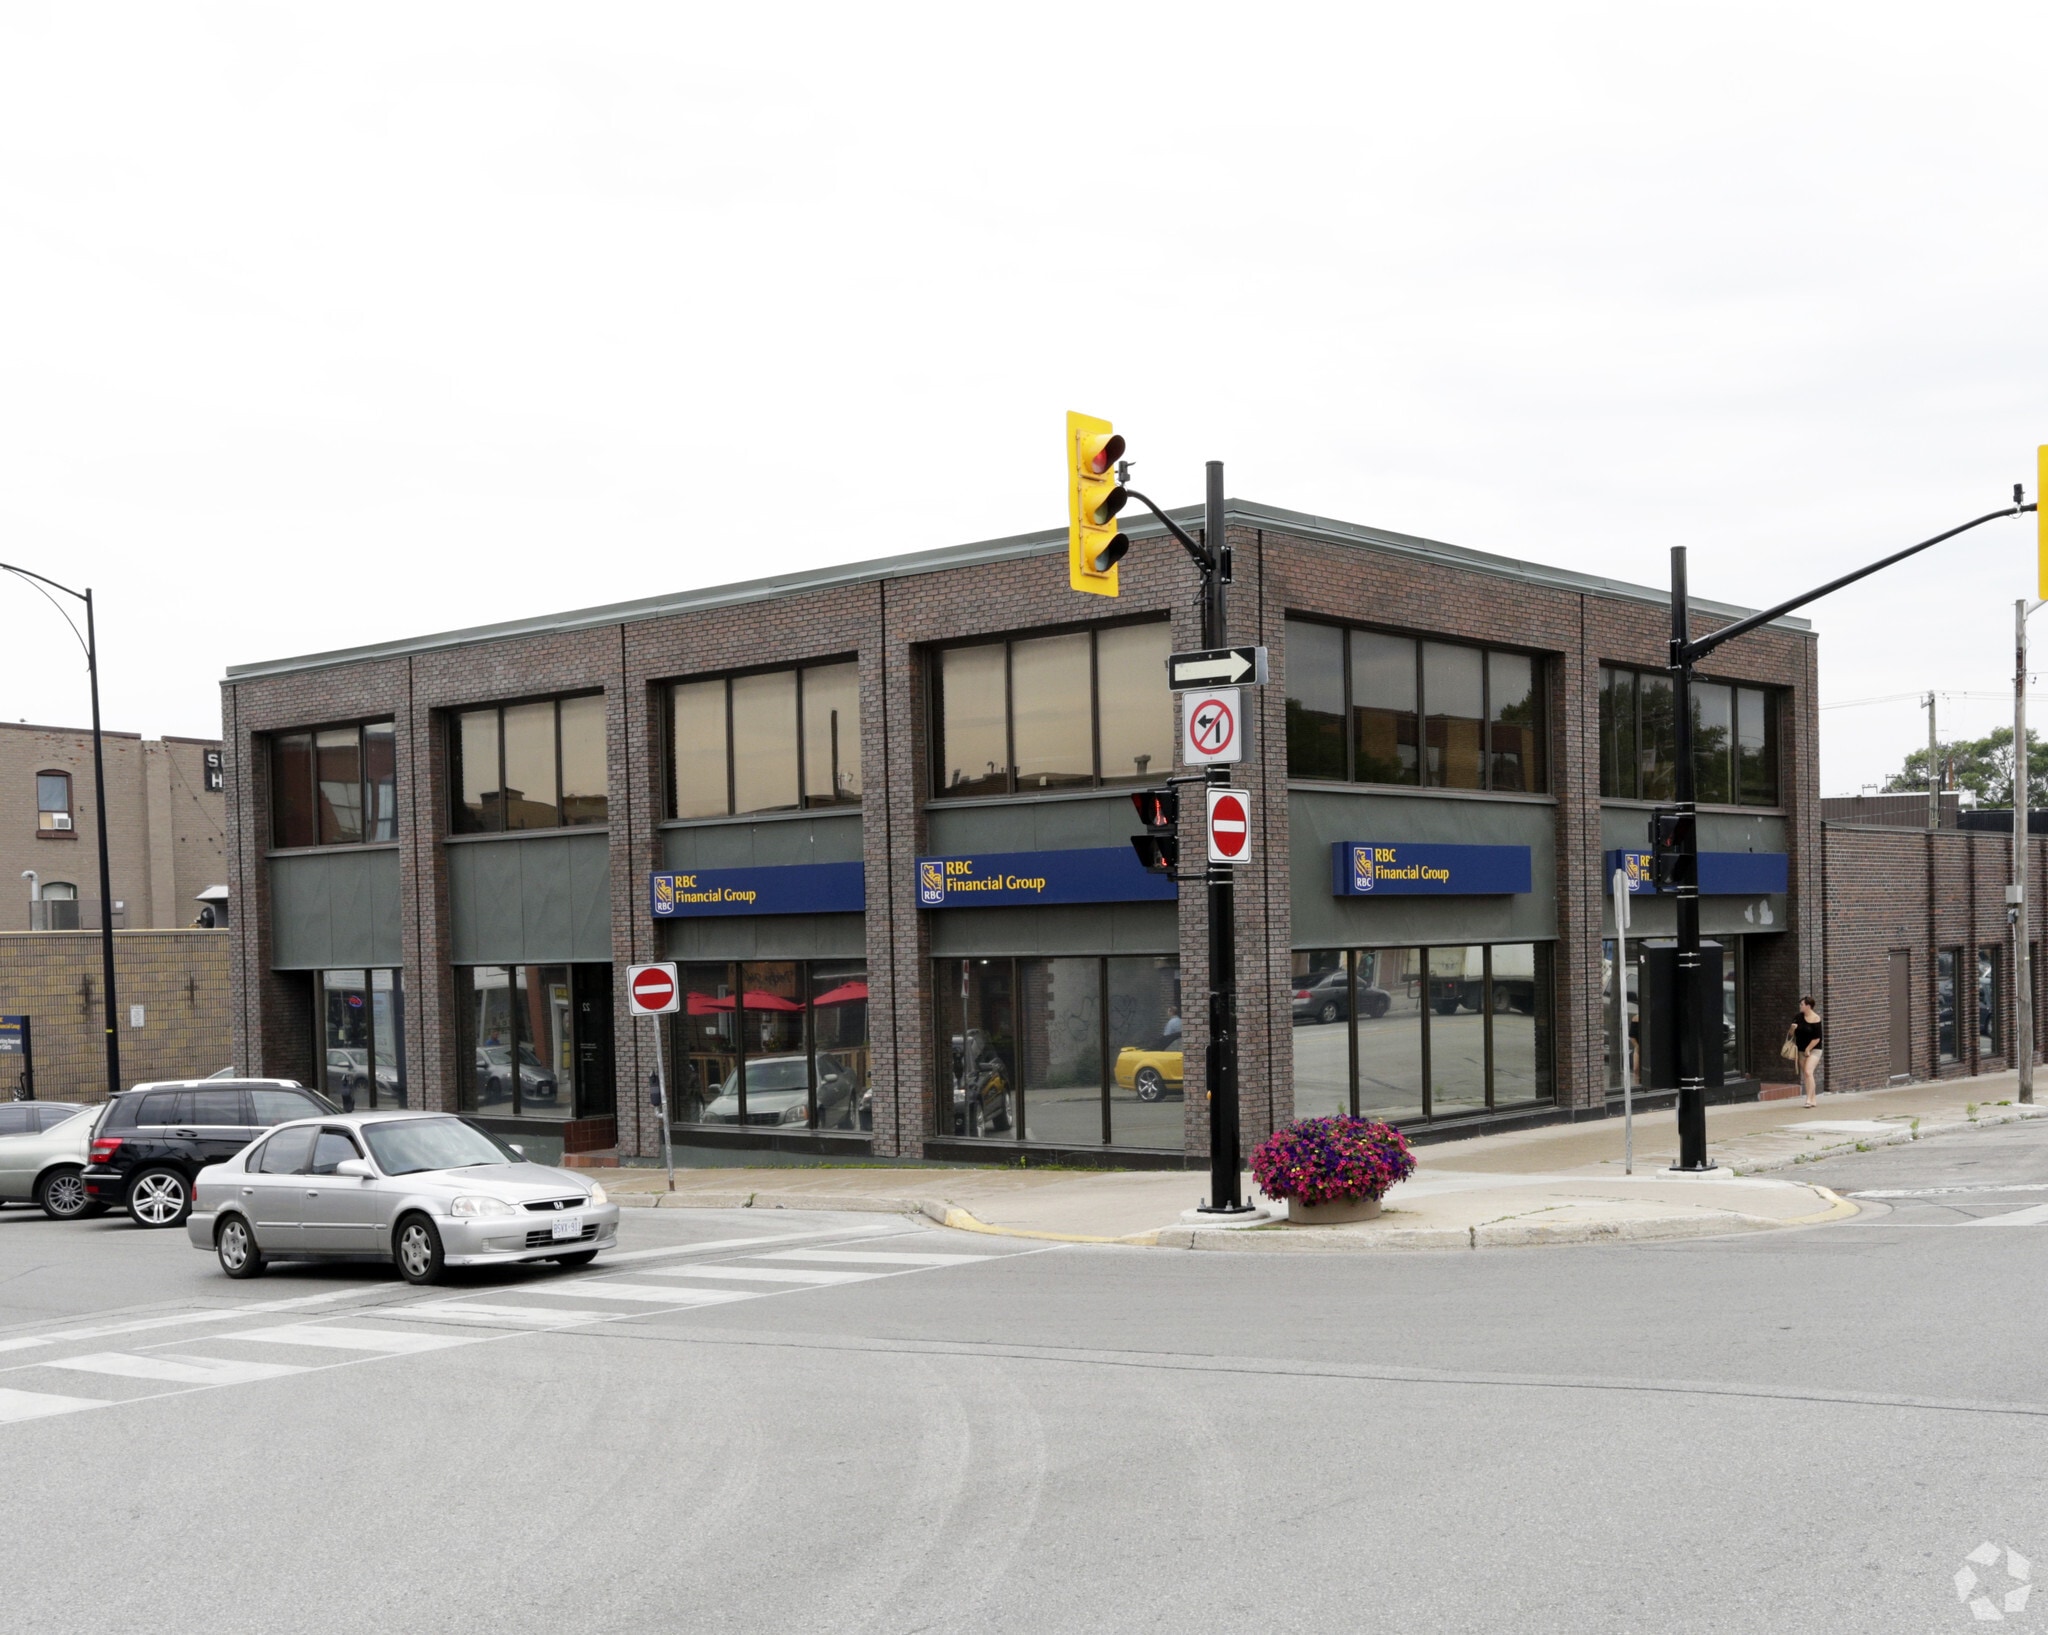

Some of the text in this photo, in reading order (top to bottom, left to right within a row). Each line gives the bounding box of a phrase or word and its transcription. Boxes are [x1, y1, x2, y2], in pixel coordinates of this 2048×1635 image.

[1375, 848, 1397, 862] RBC
[945, 859, 973, 875] RBC
[1375, 864, 1450, 884] Financial Group
[675, 875, 697, 888] RBC
[946, 874, 1046, 893] Financial Group
[1356, 877, 1372, 887] RBC
[675, 887, 756, 905] Financial Group
[924, 890, 942, 900] RBC
[657, 901, 672, 911] RBC
